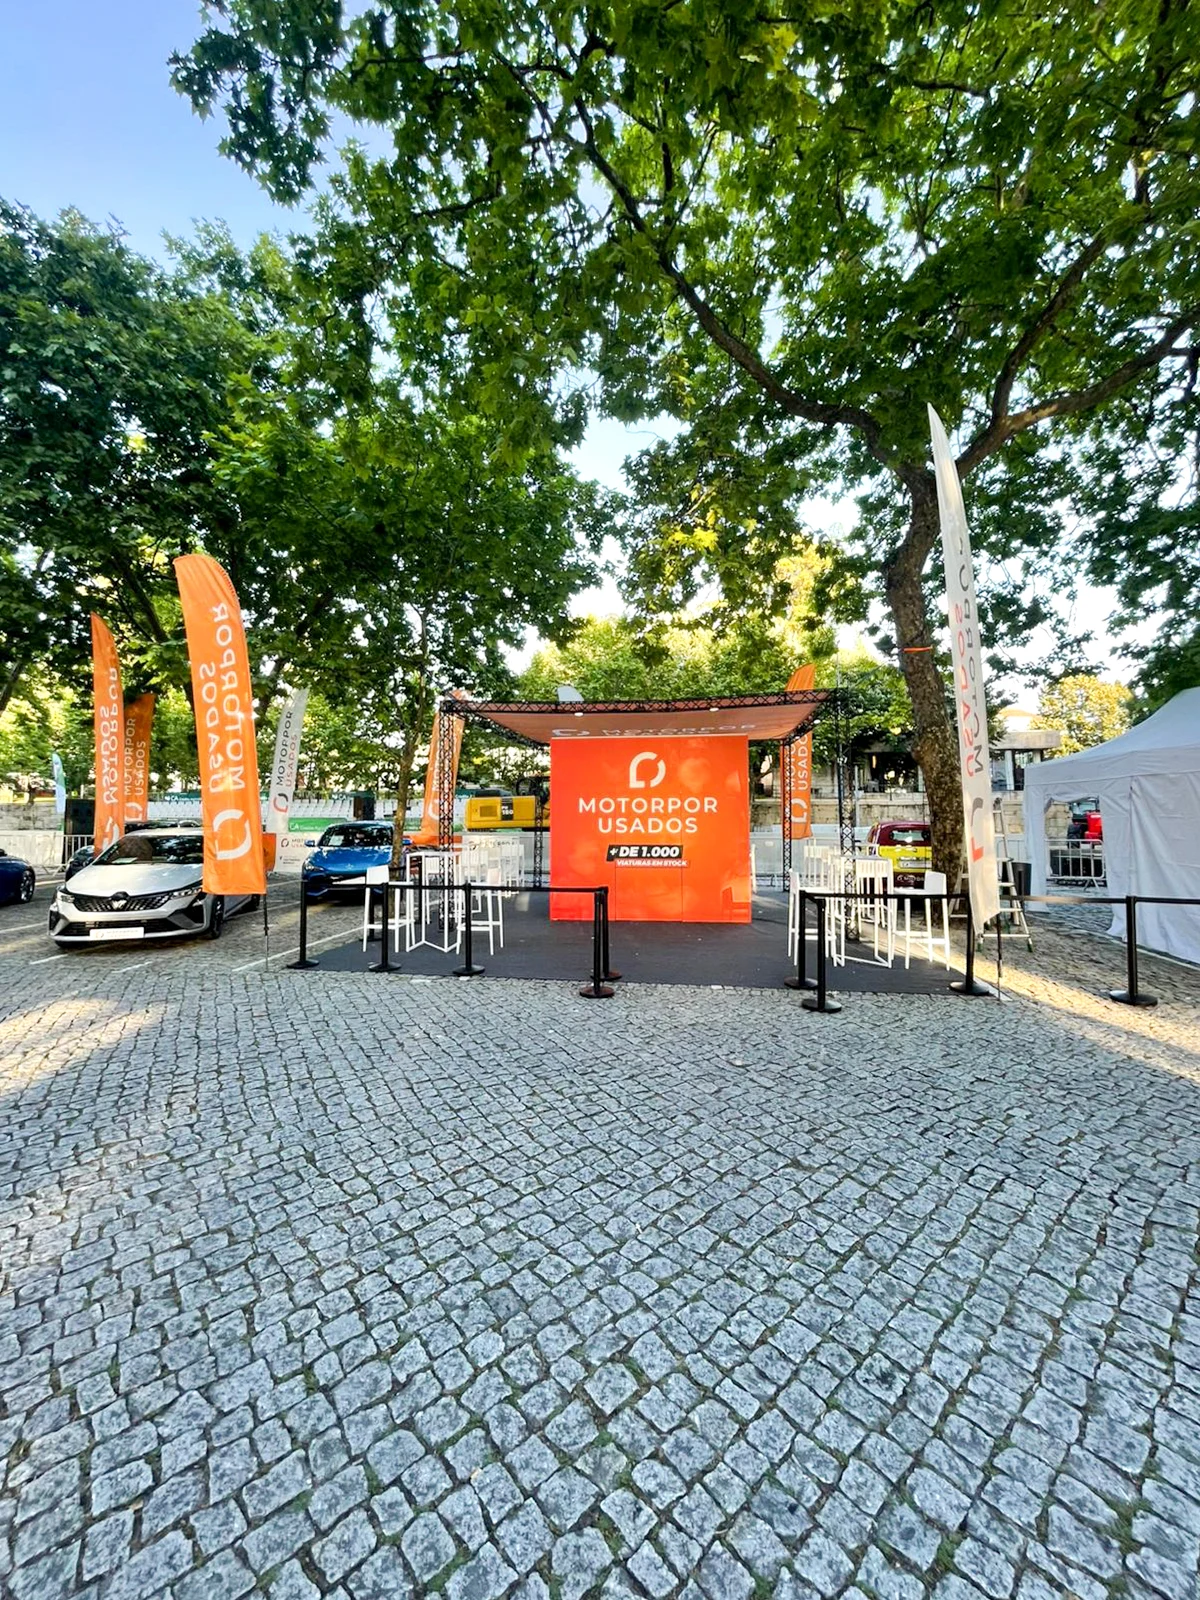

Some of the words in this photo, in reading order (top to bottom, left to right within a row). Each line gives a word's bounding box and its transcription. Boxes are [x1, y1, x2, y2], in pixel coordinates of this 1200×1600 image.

[124, 718, 136, 796] MOTORPOR
[134, 740, 146, 796] USADOS
[276, 711, 293, 786] MOTORPOR
[285, 734, 298, 787] USADOS
[797, 734, 809, 791] USADO
[578, 797, 718, 814] MOTORPOR
[598, 817, 698, 834] USADOS
[619, 845, 640, 857] DE
[641, 845, 680, 857] 1.000
